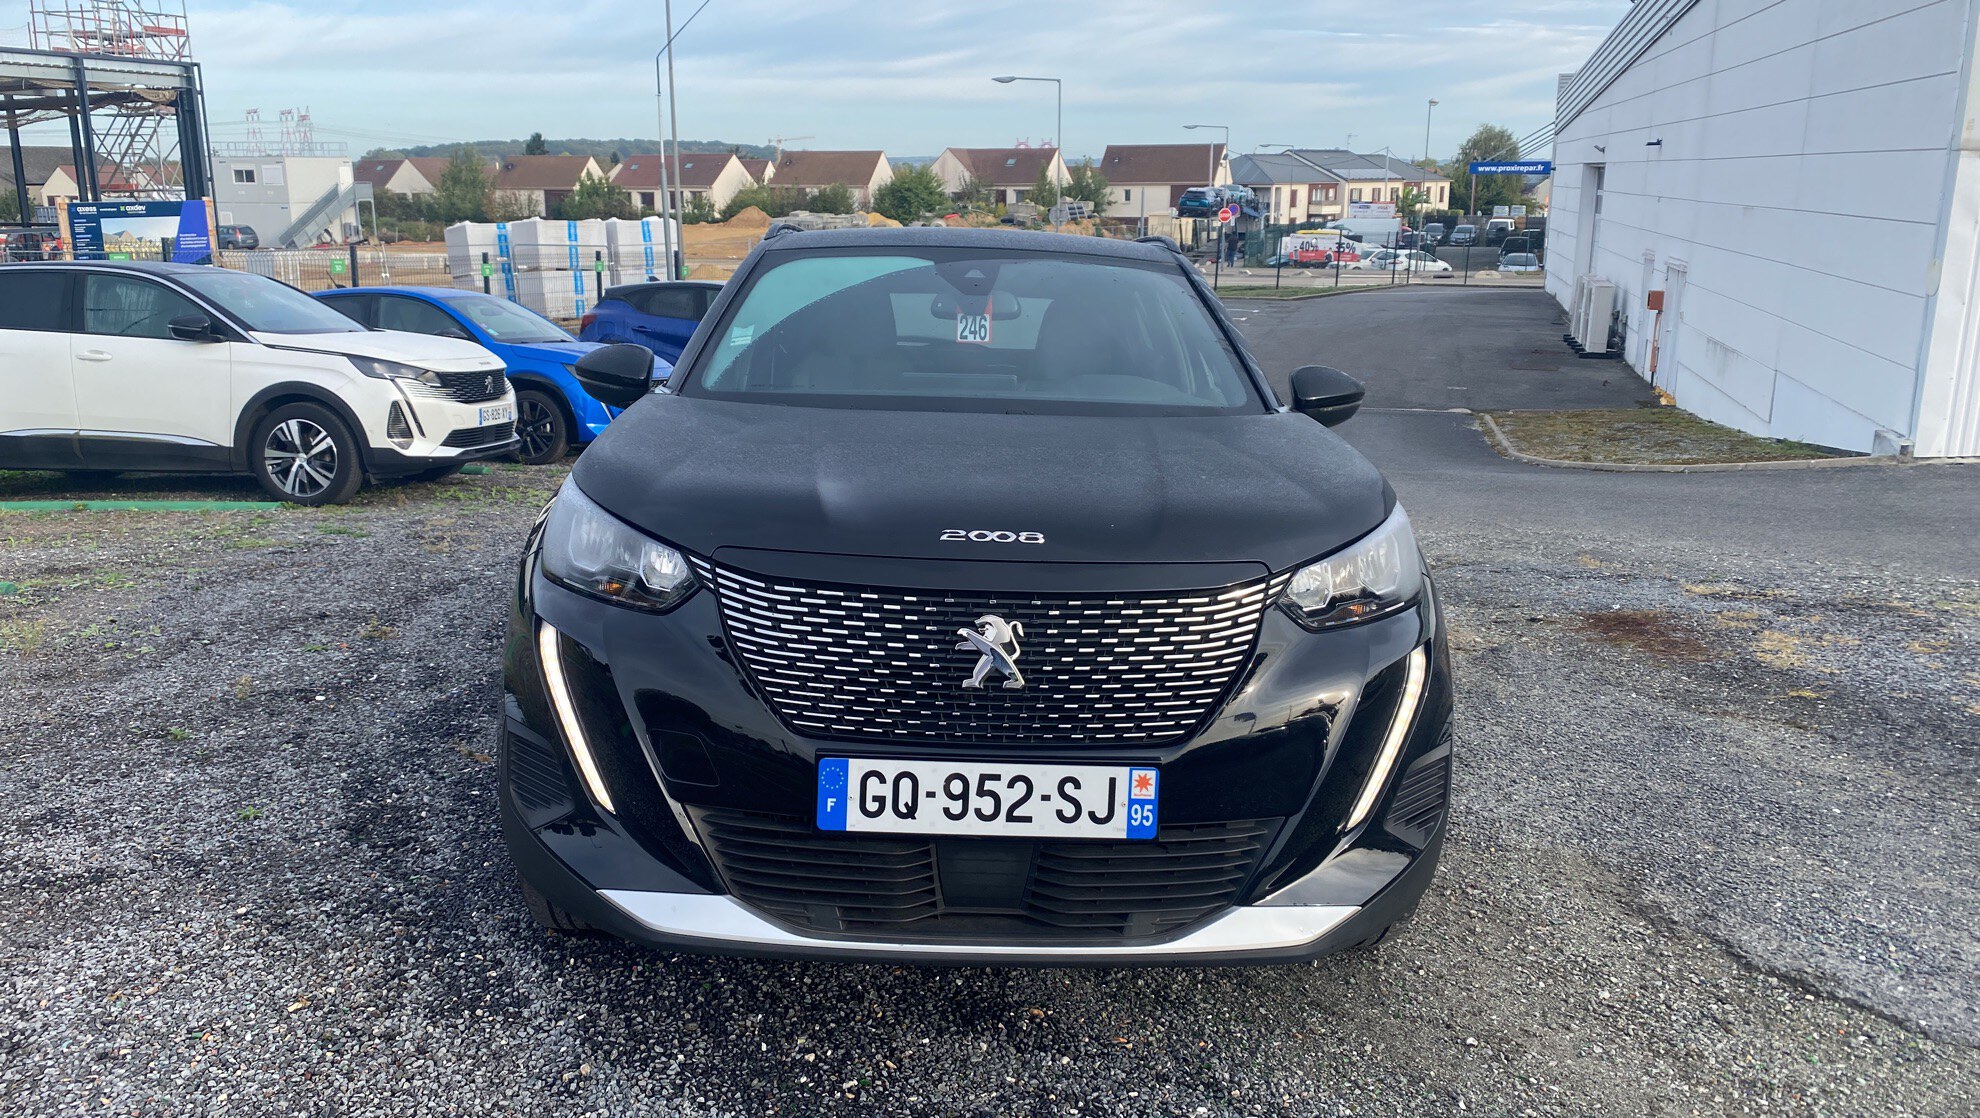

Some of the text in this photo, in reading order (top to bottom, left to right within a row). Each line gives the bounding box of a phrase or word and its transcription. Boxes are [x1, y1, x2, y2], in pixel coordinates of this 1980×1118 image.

[1478, 164, 1545, 173] www.proxirepar.fr
[959, 314, 988, 341] 246
[940, 529, 1045, 544] 2008
[827, 798, 837, 813] F
[858, 769, 1118, 826] GQ-952-SJ
[1131, 804, 1154, 827] 95
